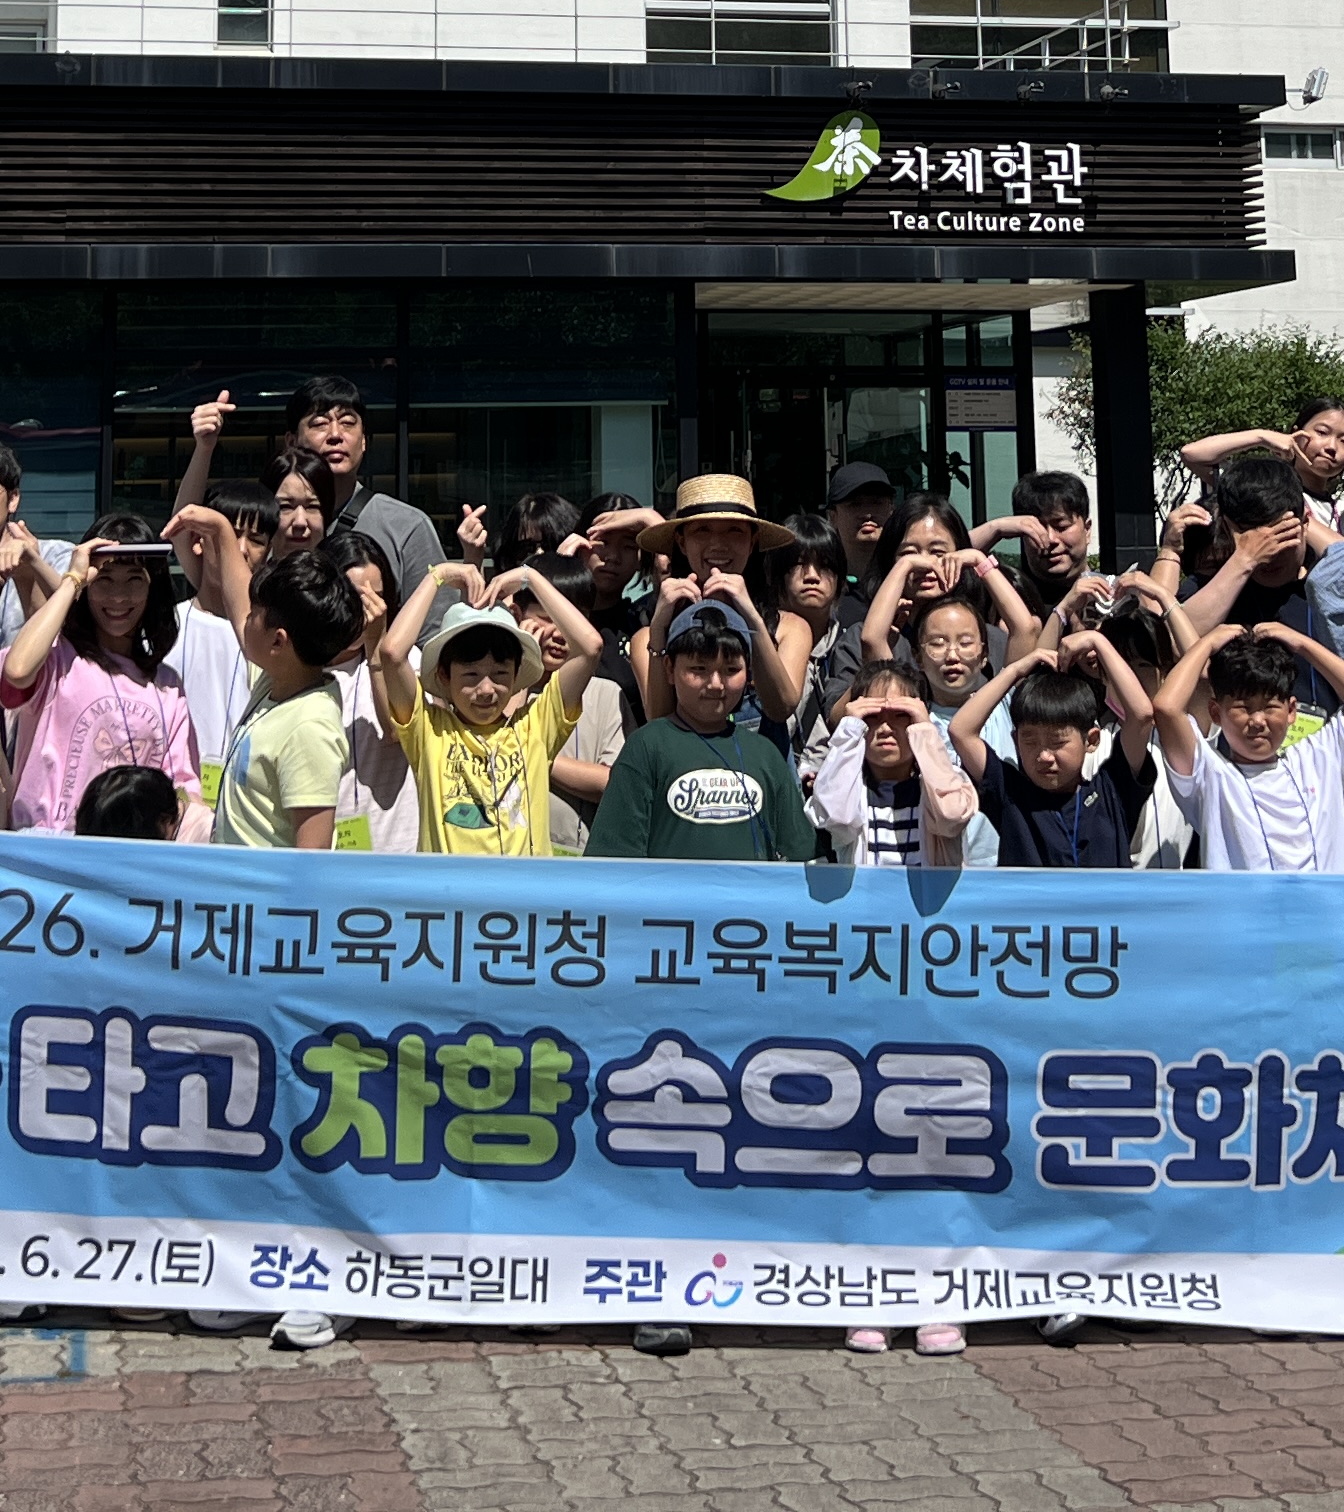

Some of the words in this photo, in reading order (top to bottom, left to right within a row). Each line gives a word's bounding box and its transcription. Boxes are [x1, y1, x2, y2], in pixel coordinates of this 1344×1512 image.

[889, 141, 1088, 205] 차체험관
[889, 211, 929, 229] Tea
[937, 211, 1021, 233] Culture
[1029, 213, 1084, 233] Zone
[124, 897, 607, 990] 거제교육지원청
[636, 915, 1128, 999] 교육복지안전망
[11, 1006, 280, 1168] 타고
[294, 1024, 587, 1178] 차향
[595, 1030, 1008, 1189] 속으로
[22, 1235, 58, 1278] 6.
[76, 1236, 215, 1286] 27.(토)
[249, 1245, 329, 1293] 장소
[345, 1250, 550, 1305] 하동군일대
[583, 1258, 666, 1305] 주관
[753, 1262, 919, 1309] 경상남도
[933, 1266, 1220, 1313] 거제교육지원청
